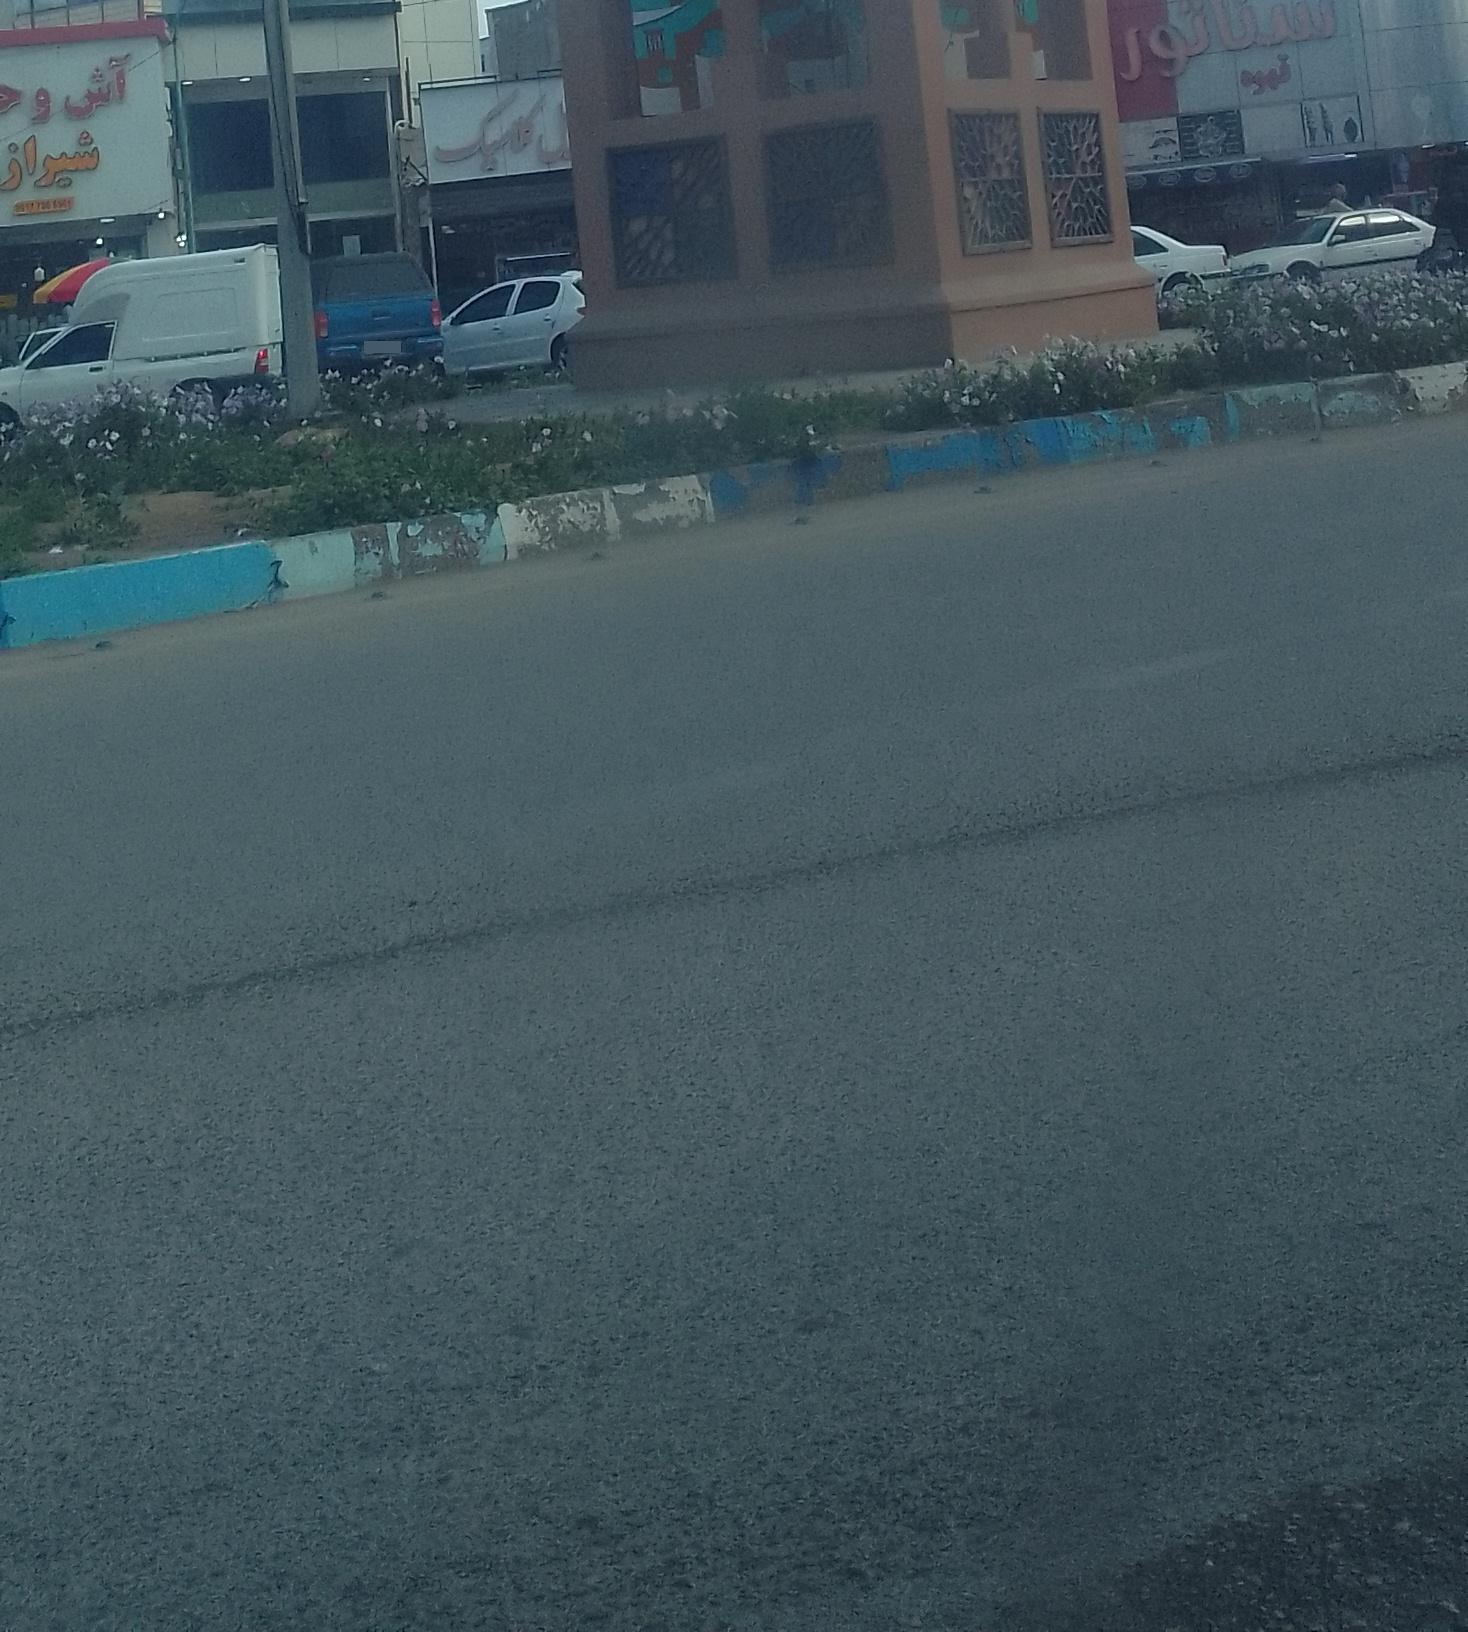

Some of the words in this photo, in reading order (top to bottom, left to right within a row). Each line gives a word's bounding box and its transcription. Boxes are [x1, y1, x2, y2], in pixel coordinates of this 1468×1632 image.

[31, 87, 52, 124] و
[64, 53, 131, 118] آش
[0, 131, 100, 191] شیراز
